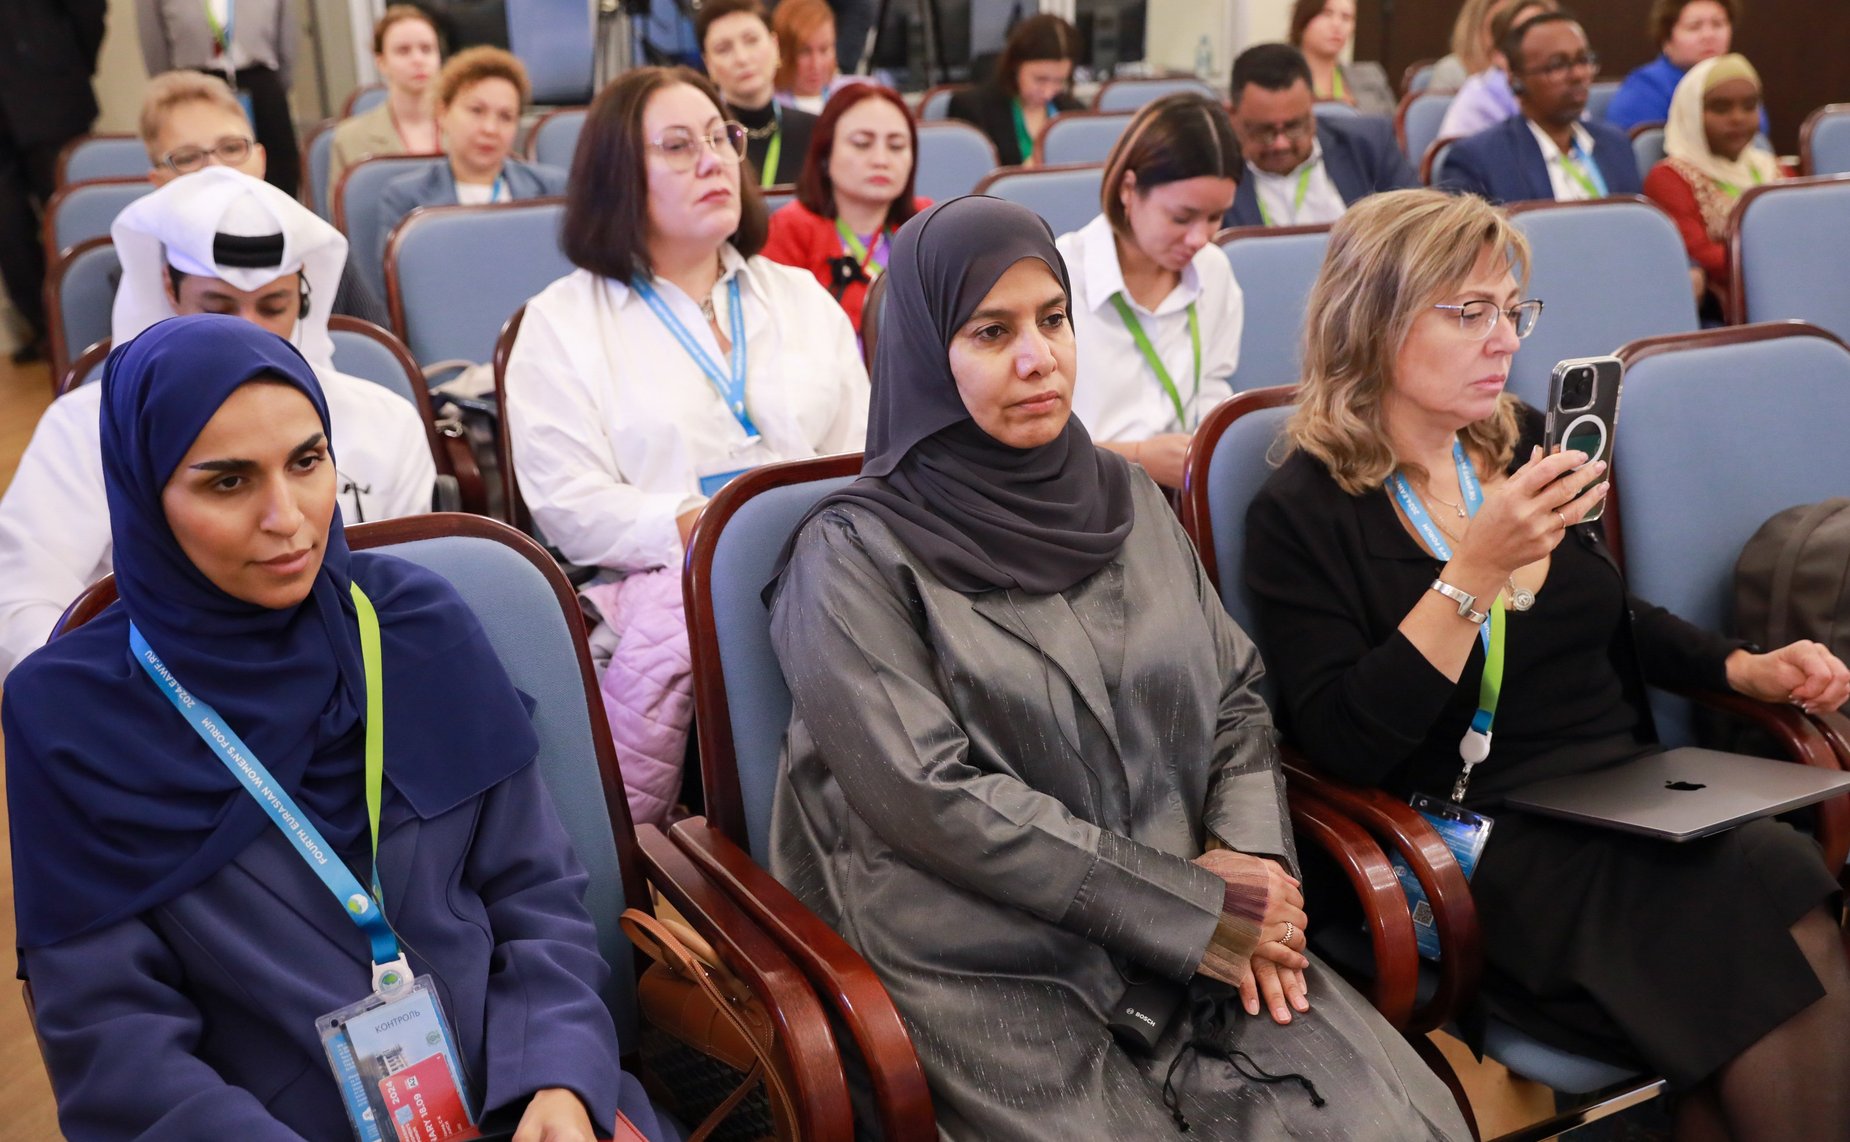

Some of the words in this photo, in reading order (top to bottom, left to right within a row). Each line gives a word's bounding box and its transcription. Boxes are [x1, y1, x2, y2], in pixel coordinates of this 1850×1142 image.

[144, 650, 196, 709] 2024.EAWF.RU
[202, 717, 229, 748] FORUM
[226, 746, 264, 788] WOMEN'S
[261, 786, 301, 831] EURASIAN
[297, 828, 328, 865] FOURTH
[374, 1010, 421, 1034] КОНТРОЛЬ
[1135, 1011, 1156, 1027] BOSCH
[386, 1080, 400, 1105] 2024
[413, 1093, 428, 1118] 18.09
